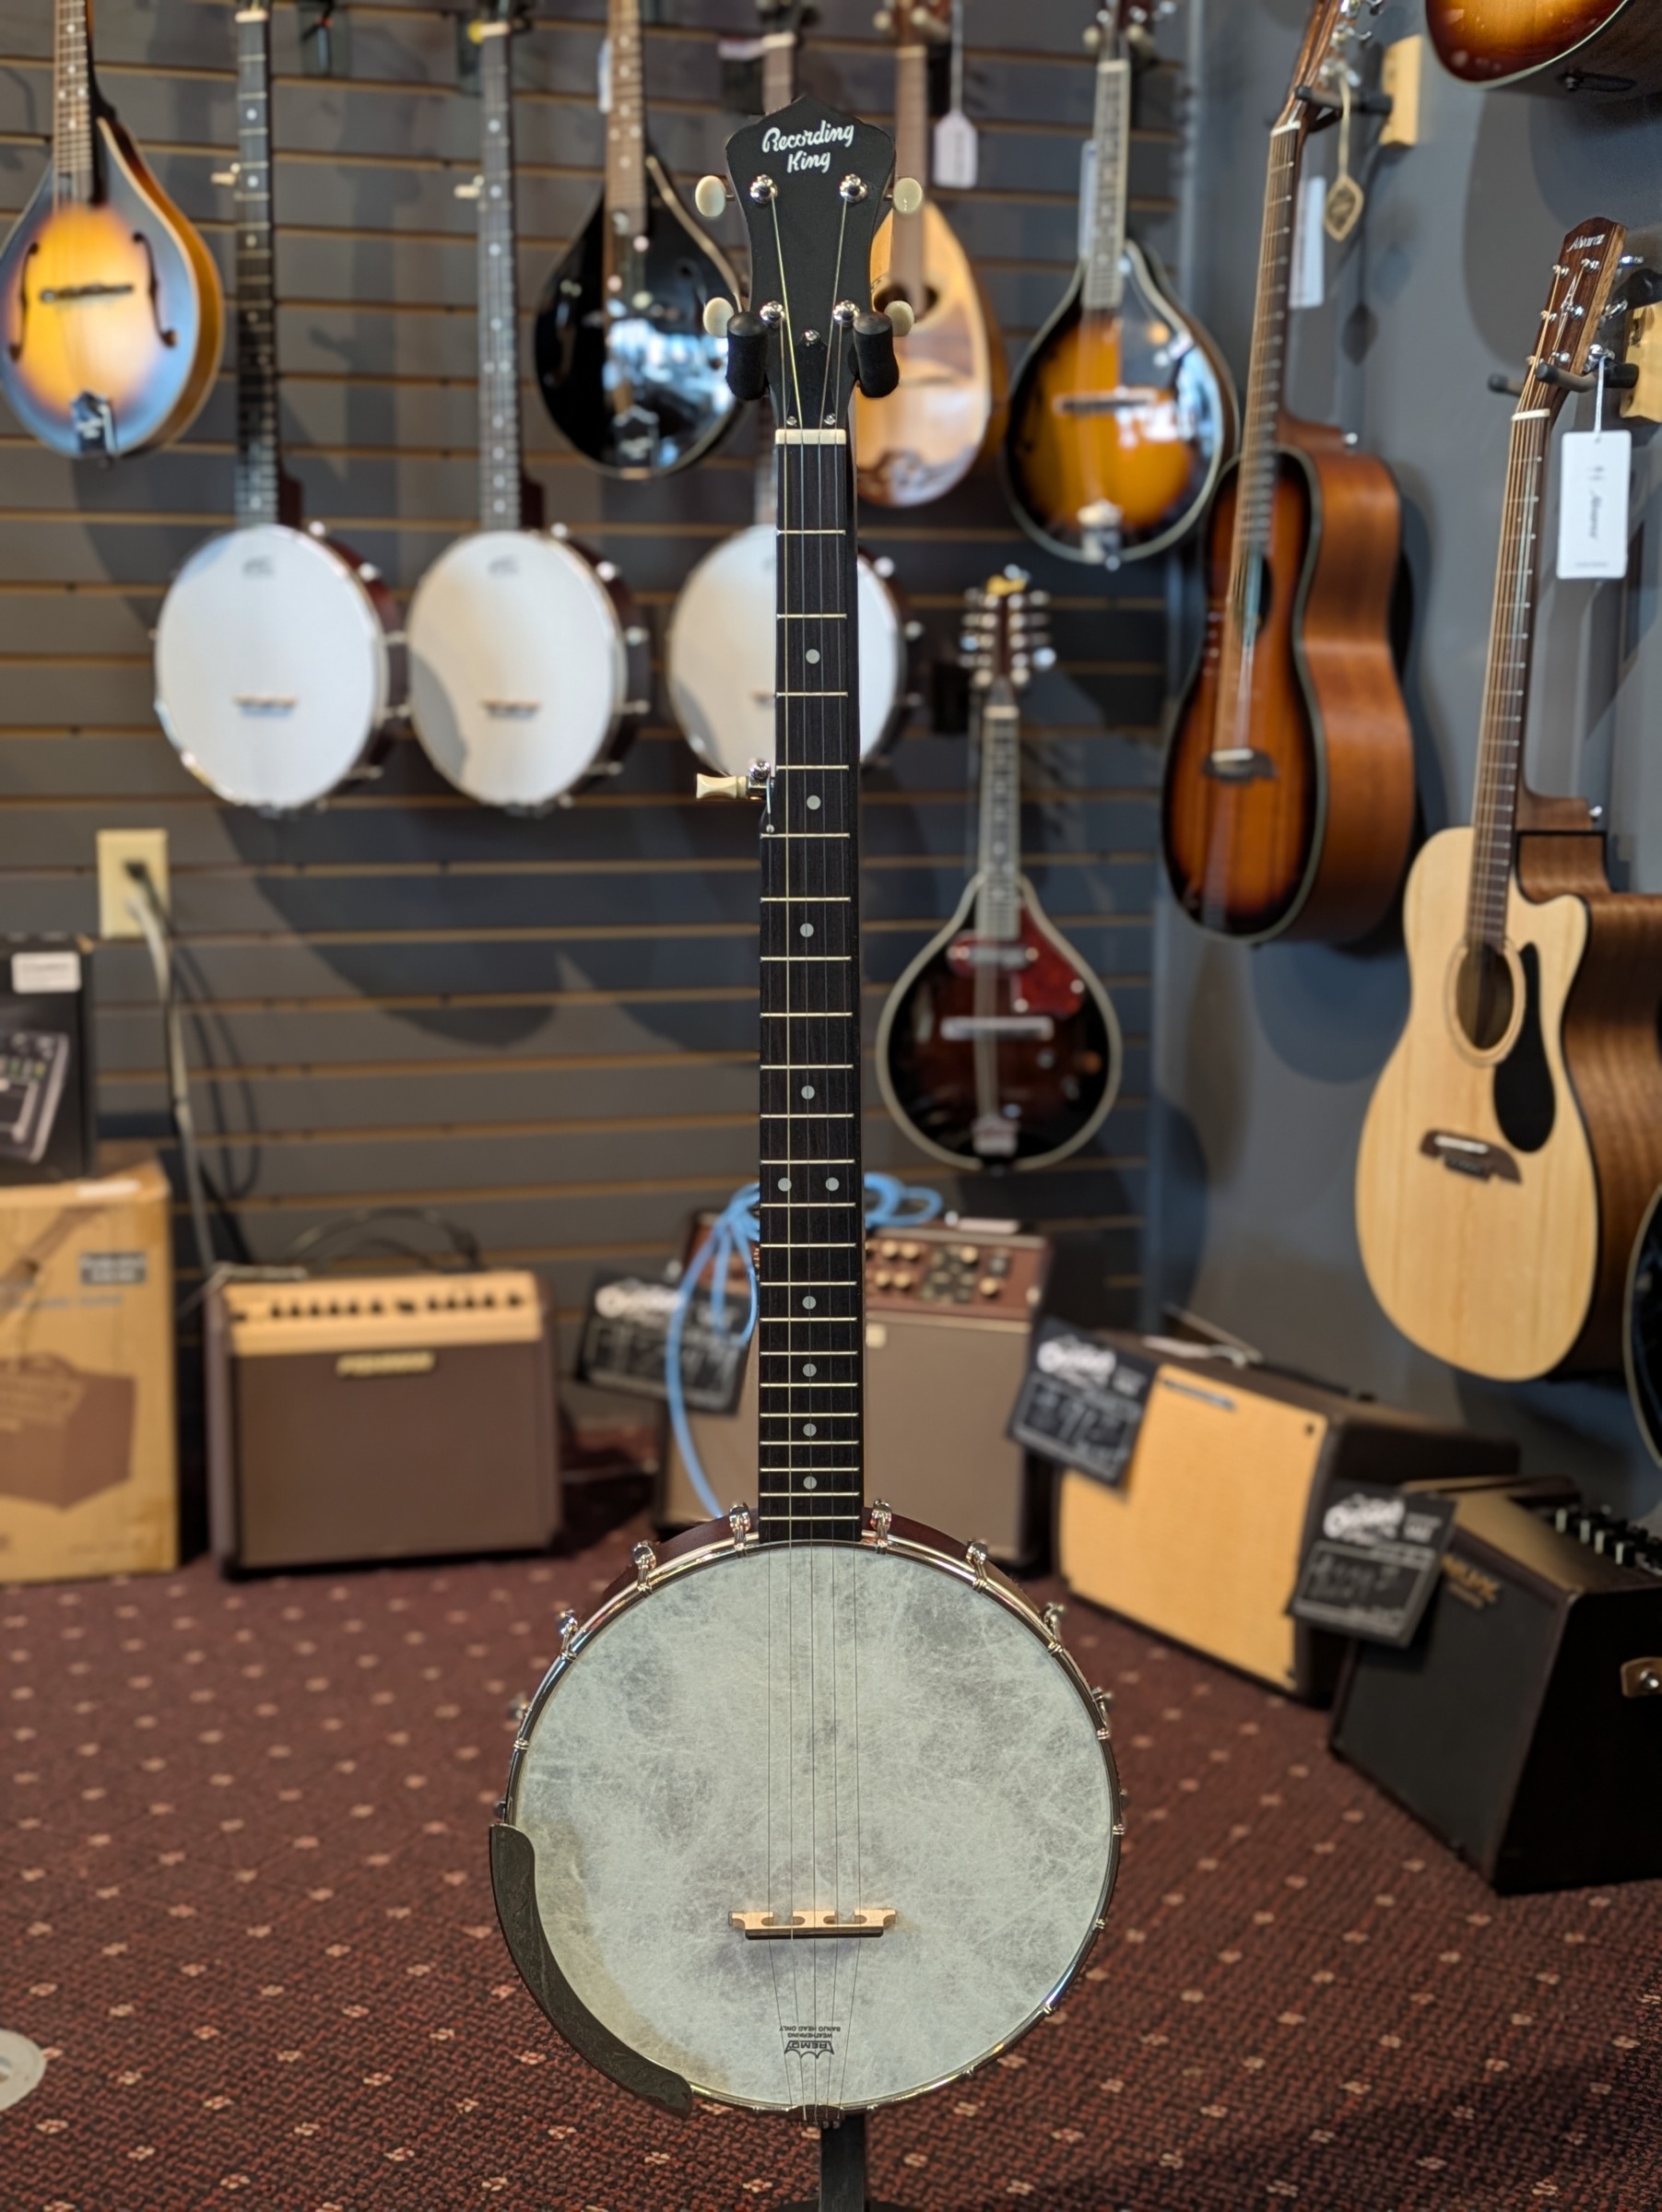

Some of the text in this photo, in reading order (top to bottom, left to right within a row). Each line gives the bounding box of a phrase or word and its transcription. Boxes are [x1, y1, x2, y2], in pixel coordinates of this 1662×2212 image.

[761, 120, 855, 153] Recording
[786, 150, 831, 173] King
[1566, 234, 1606, 253] Alvarez
